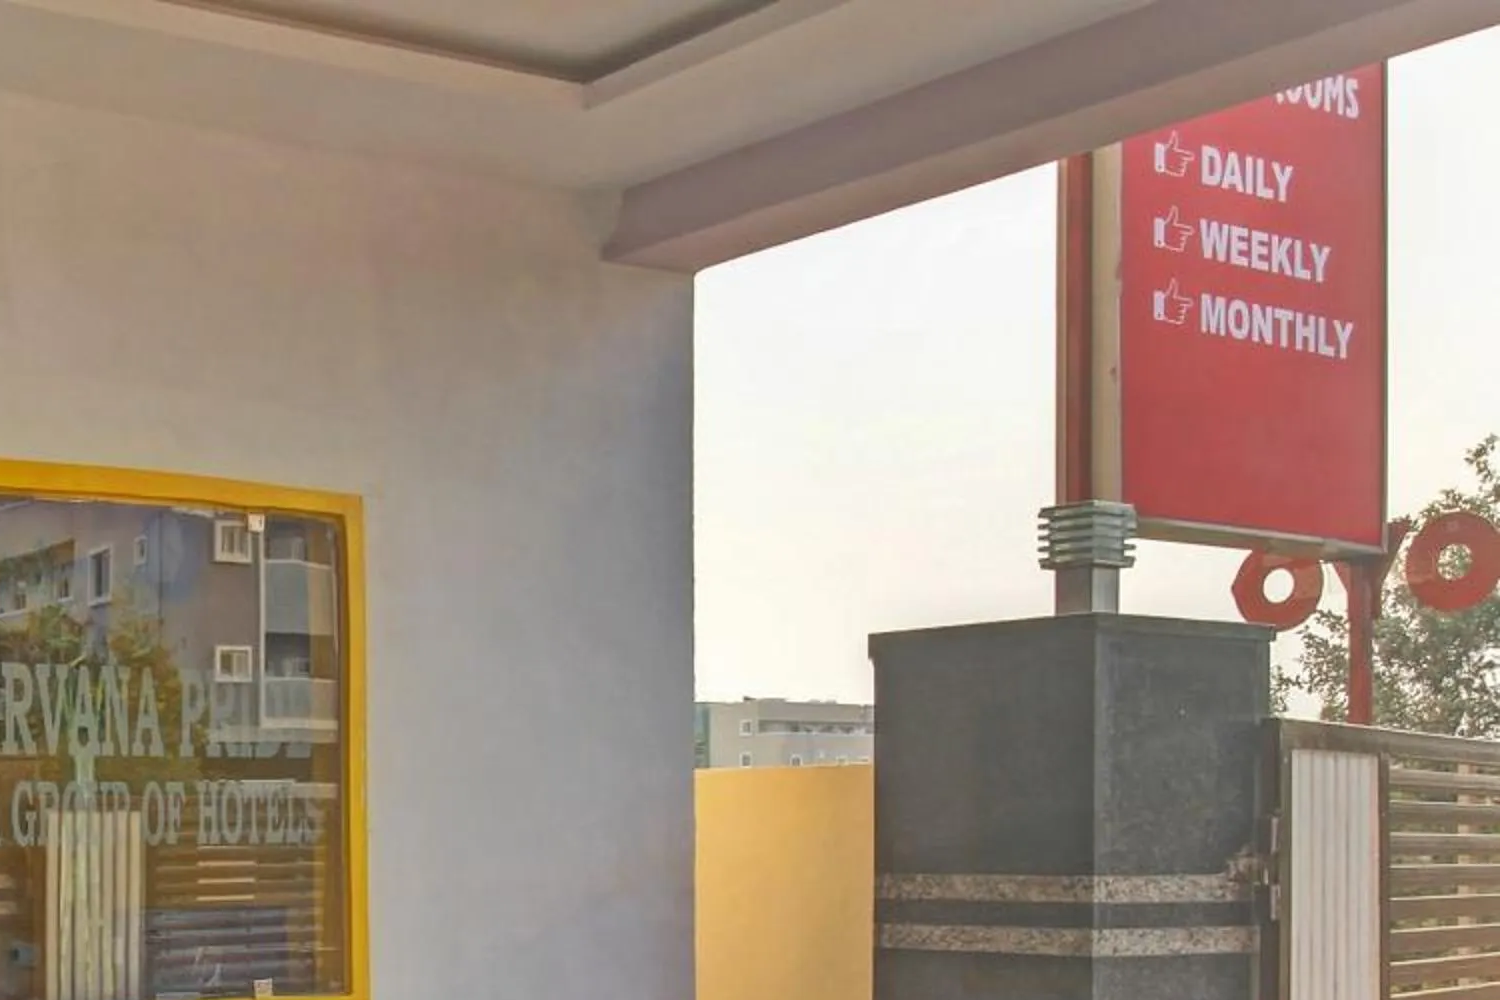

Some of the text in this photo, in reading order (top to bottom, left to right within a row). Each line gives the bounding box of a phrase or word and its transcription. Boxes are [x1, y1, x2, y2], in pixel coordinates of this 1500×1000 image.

[1276, 74, 1359, 119] OMS
[1201, 145, 1294, 202] DAILY
[1200, 218, 1332, 283] WEEKLY
[1201, 293, 1354, 360] MONTHLY
[179, 668, 312, 759] PRID
[141, 780, 186, 846] OF
[196, 779, 325, 845] HOTELS
